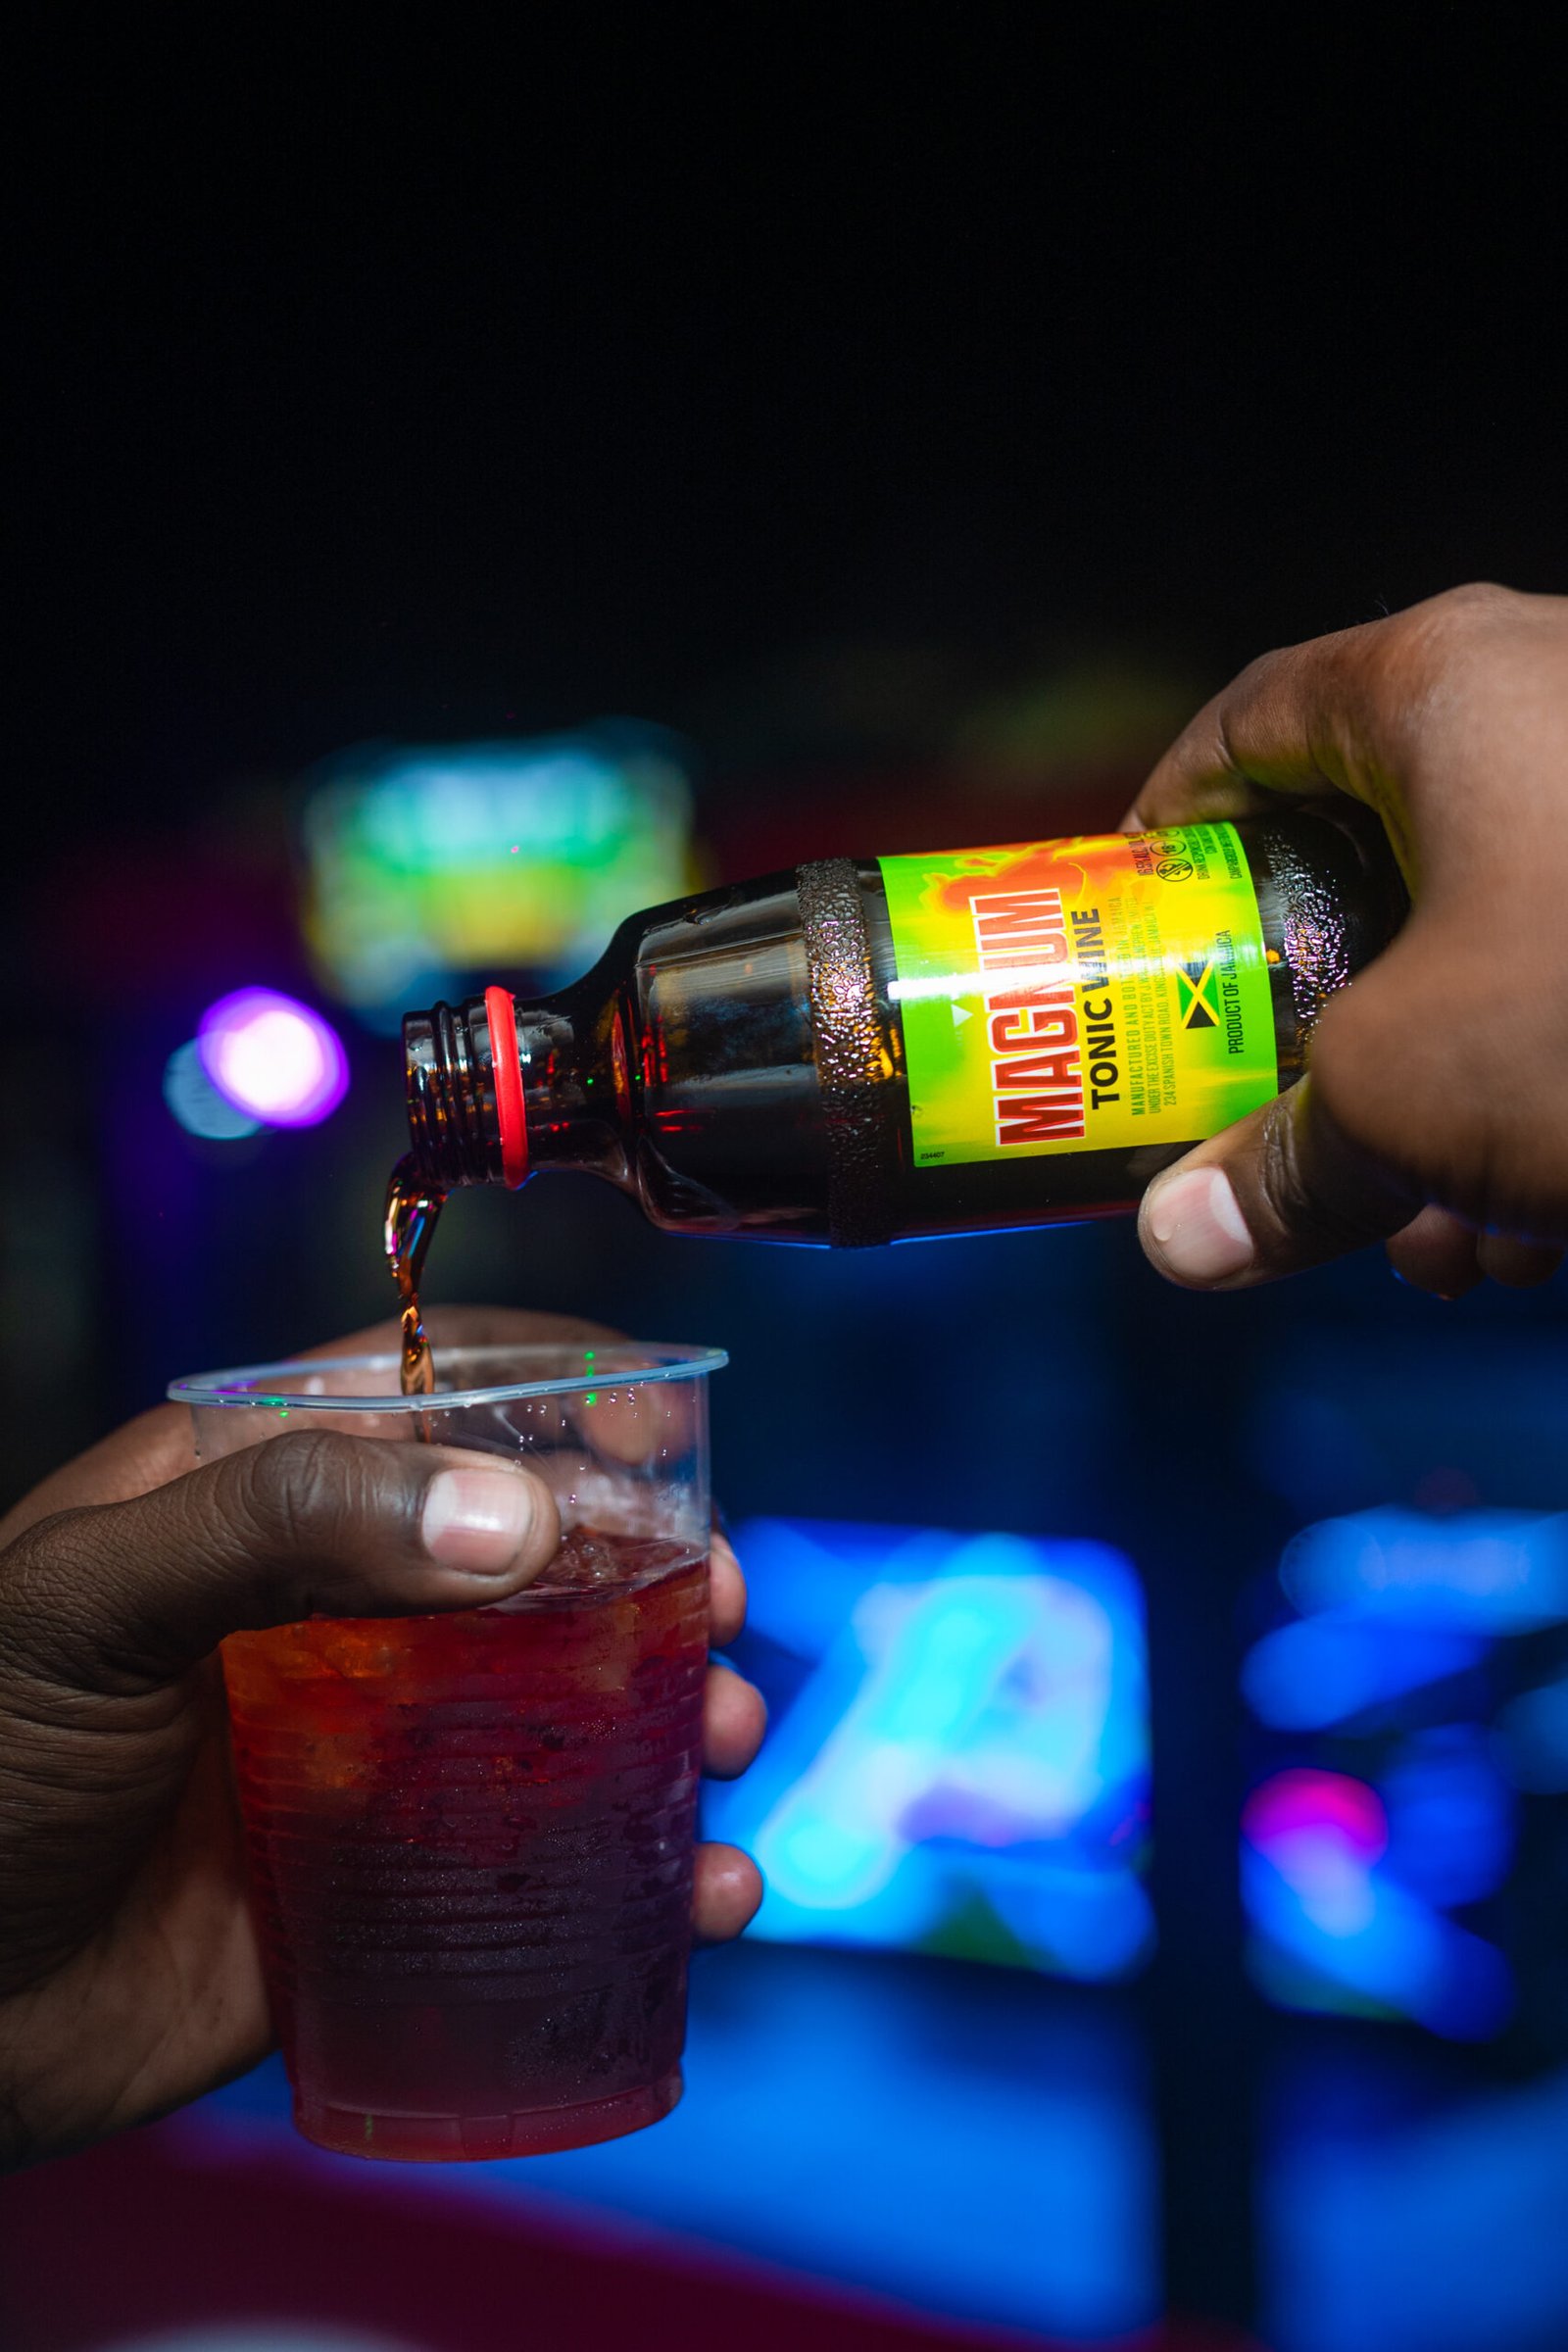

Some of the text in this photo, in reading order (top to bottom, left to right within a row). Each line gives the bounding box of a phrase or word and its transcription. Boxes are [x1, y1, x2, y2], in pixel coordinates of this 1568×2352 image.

[1117, 954, 1137, 1000] BOTTD
[1151, 956, 1167, 997] KINGSN
[1140, 992, 1152, 1002] BY
[1215, 929, 1245, 1054] PRODUCT OF JAMAICA
[970, 890, 1085, 1146] MAGNUM
[1071, 908, 1120, 1110] TONIC WINE
[1123, 1004, 1139, 1026] AND
[1142, 1002, 1155, 1019] ACT
[1144, 1020, 1156, 1042] DUTY
[1158, 1025, 1173, 1051] TOWN
[1146, 1044, 1159, 1070] EXCISE
[1126, 1030, 1145, 1115] MANUFACTURED
[1148, 1072, 1159, 1086] THE
[1160, 1053, 1176, 1089] SPANISH
[1149, 1090, 1161, 1113] UNDER
[1163, 1091, 1176, 1105] 234
